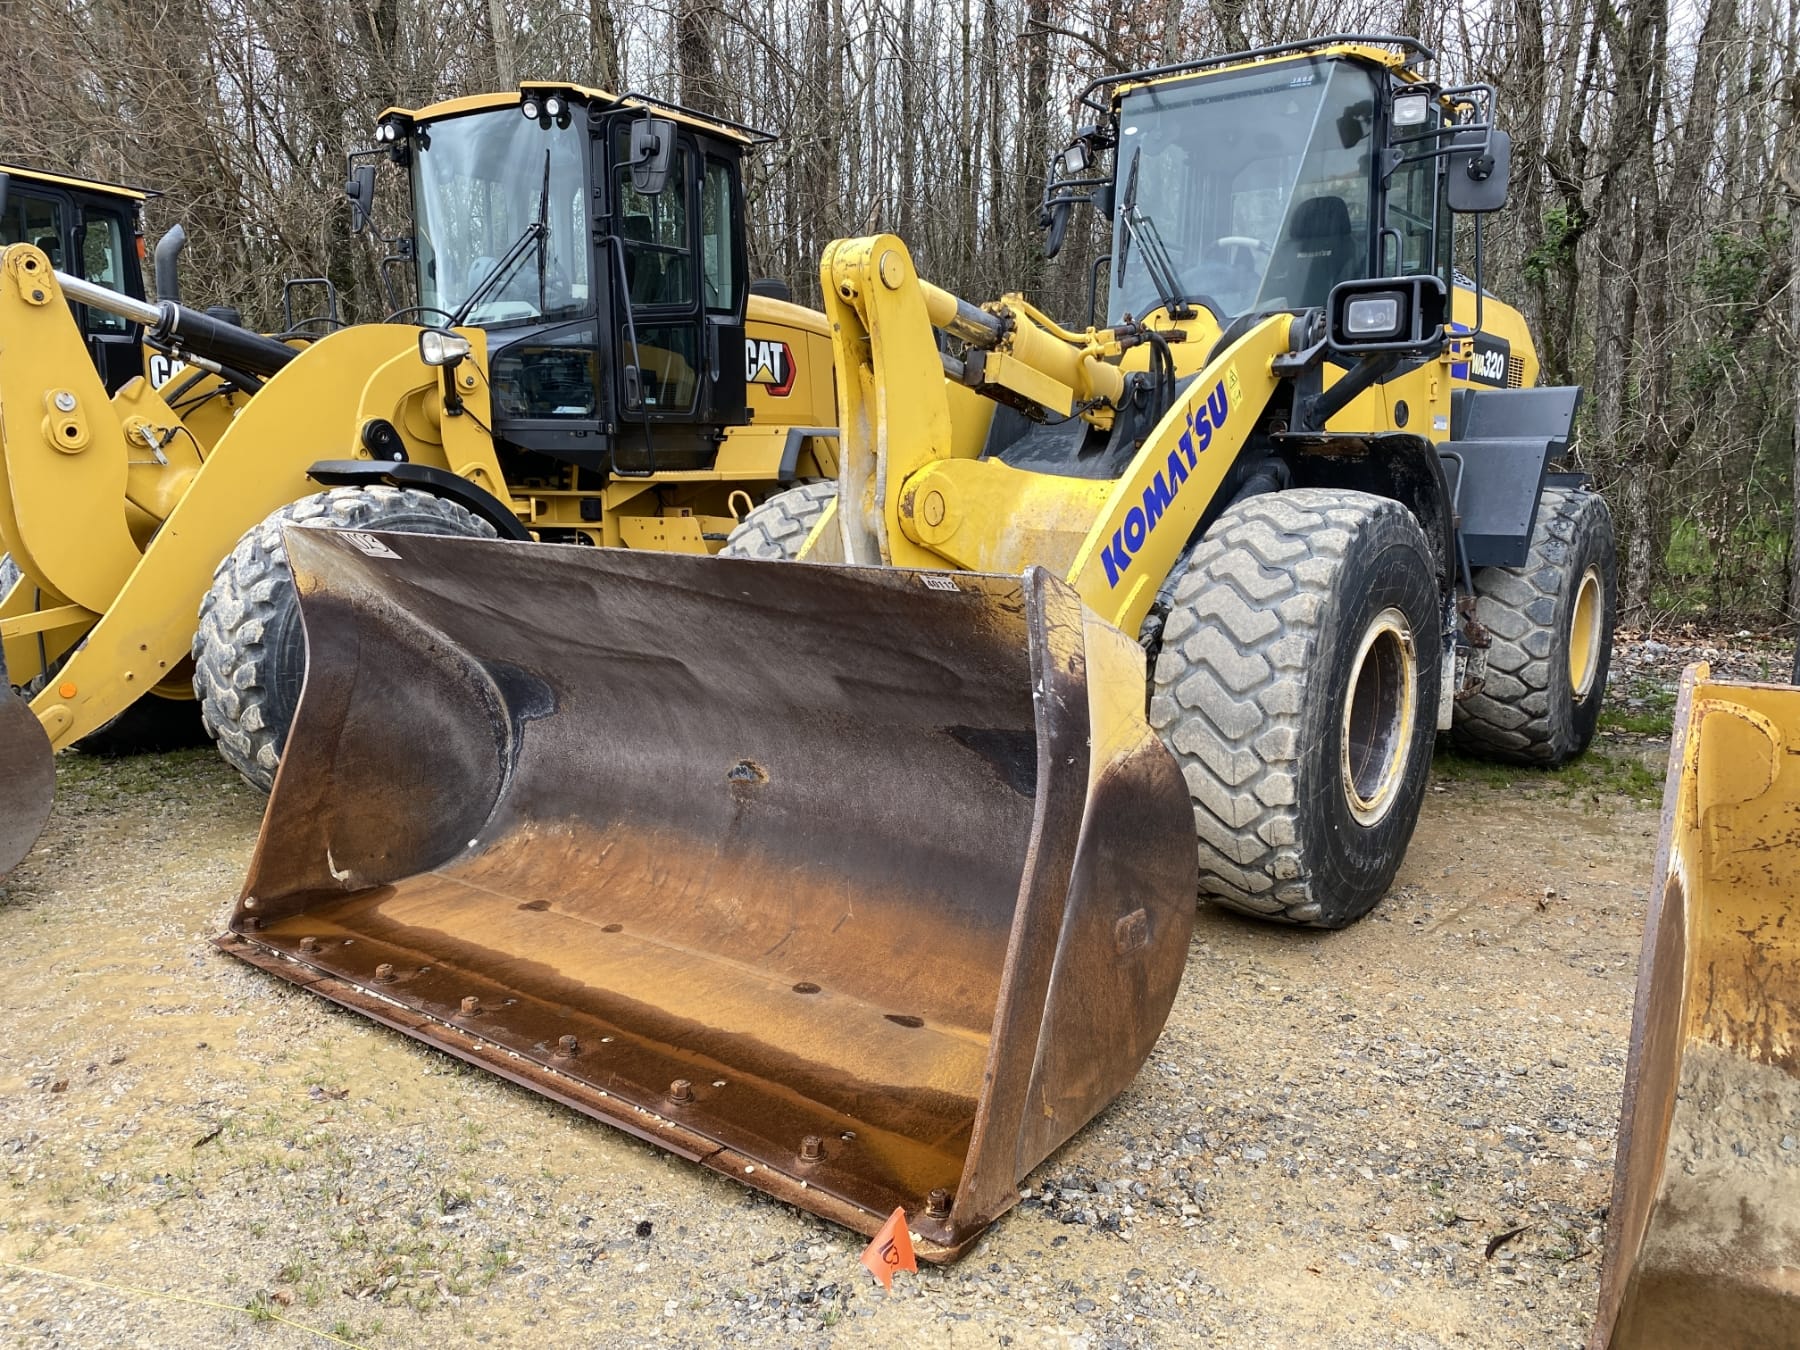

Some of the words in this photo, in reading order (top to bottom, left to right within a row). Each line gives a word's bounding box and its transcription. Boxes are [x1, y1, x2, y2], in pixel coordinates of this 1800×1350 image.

[745, 339, 783, 383] CAT
[1471, 350, 1504, 380] WA320
[1101, 380, 1228, 589] KOMATSU
